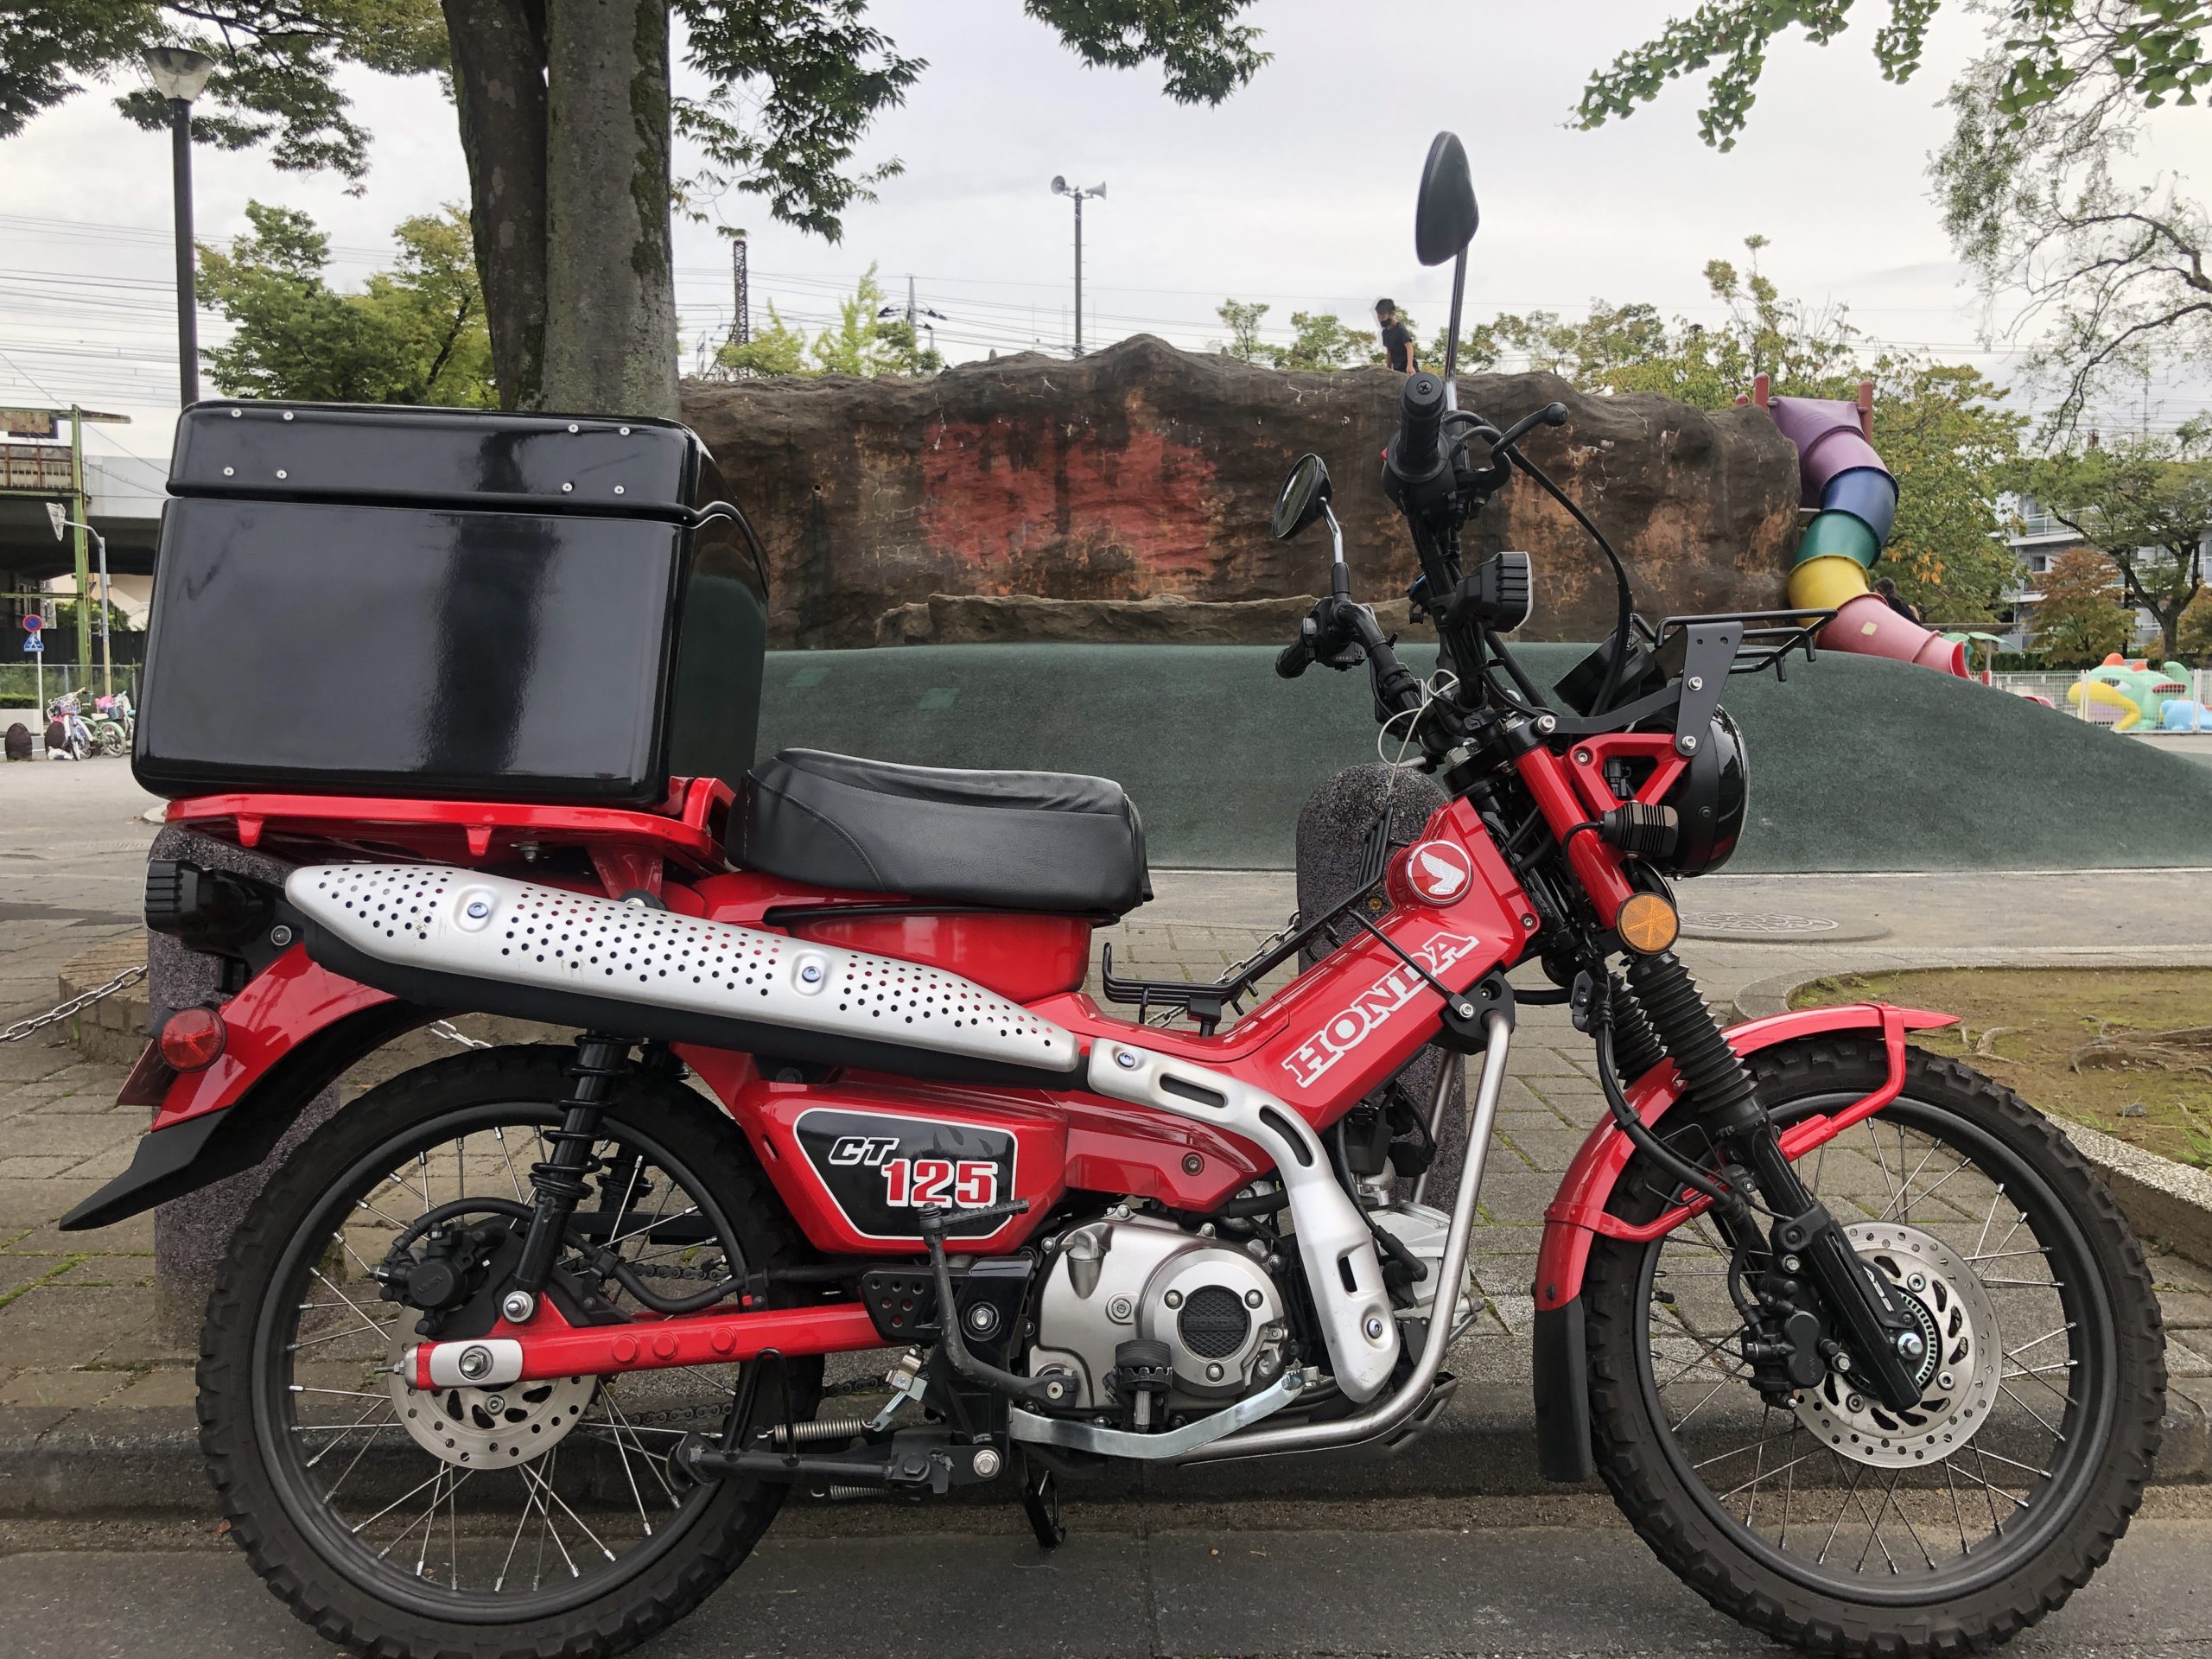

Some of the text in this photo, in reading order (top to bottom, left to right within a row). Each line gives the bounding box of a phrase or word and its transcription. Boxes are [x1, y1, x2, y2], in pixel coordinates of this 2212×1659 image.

[1281, 931, 1480, 1089] HONDA
[828, 1135, 900, 1166] CT
[880, 1158, 998, 1209] 125
[1862, 1265, 1895, 1312] ABS
[1187, 1319, 1242, 1328] HONDA
